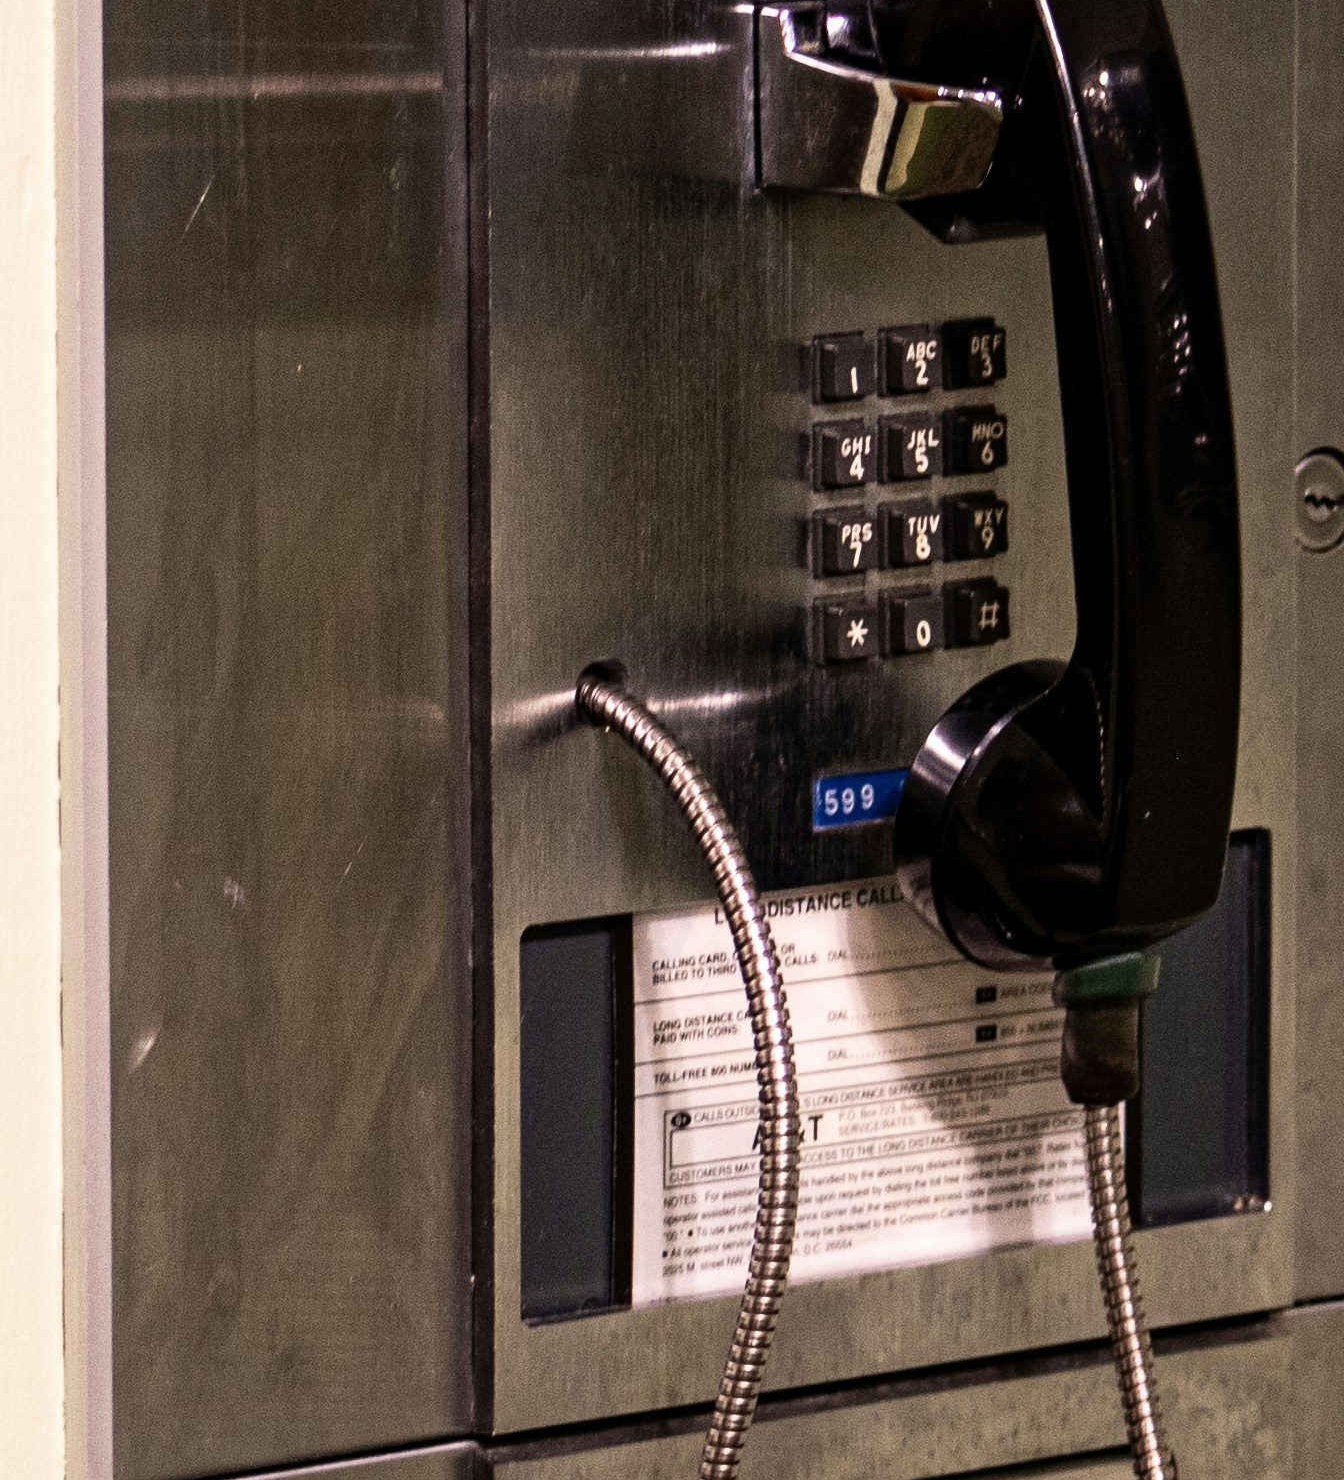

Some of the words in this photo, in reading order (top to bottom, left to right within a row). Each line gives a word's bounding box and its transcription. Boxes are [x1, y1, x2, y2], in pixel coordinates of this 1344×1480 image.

[906, 340, 938, 363] ABC
[971, 334, 1002, 355] DEF
[915, 361, 929, 386] 2
[981, 354, 993, 378] 3
[850, 366, 859, 393] 1
[907, 428, 939, 450] JKL
[971, 421, 1003, 441] MNO
[841, 436, 872, 455] GHI
[981, 439, 994, 465] 6
[848, 454, 865, 480] 4
[914, 447, 929, 473] 5
[908, 515, 940, 536] TUV
[973, 507, 1005, 526] WXY
[841, 523, 873, 544] PRS
[981, 525, 994, 549] 9
[851, 541, 863, 568] 7
[915, 534, 930, 559] 8
[917, 620, 931, 646] 0
[824, 784, 875, 816] 599
[768, 892, 852, 918] DISTANCE
[857, 886, 905, 908] CALL
[652, 955, 695, 971] CALLING
[780, 943, 795, 954] OR
[652, 968, 688, 984] BILLED
[691, 966, 704, 980] TO
[707, 964, 737, 978] THIRD
[653, 1020, 682, 1034] LONG
[684, 1013, 734, 1029] DISTANCE
[653, 1032, 678, 1046] PAID
[680, 1029, 704, 1043] WITH
[654, 1070, 707, 1086] TOLL-FREE
[735, 1162, 756, 1174] MAY
